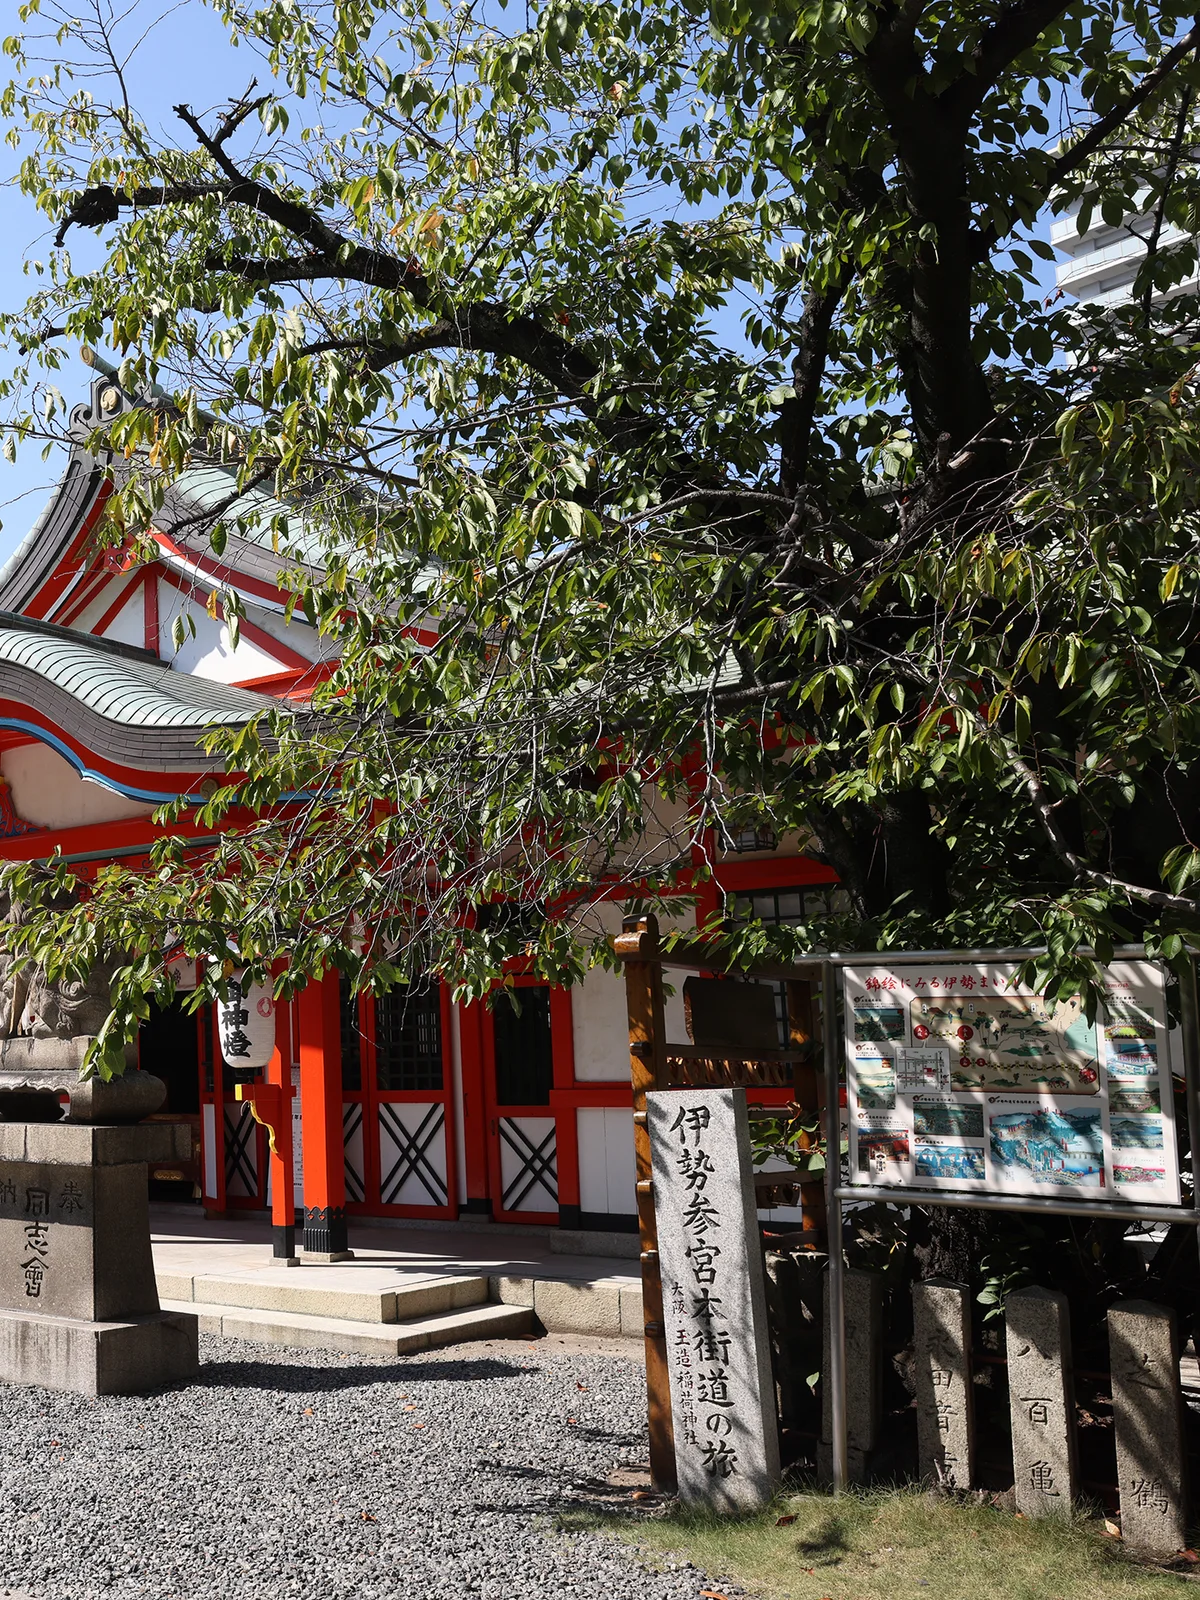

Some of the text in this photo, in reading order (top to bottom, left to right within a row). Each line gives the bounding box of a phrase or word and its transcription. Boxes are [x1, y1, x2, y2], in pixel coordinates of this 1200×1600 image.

[865, 974, 1018, 993] 錦絵にみる伊勢まい
[669, 1105, 738, 1479] 伊勢参宮本街道の旅
[671, 1281, 699, 1446] 大阪・玉造稲荷神社
[1017, 1337, 1060, 1497] 八百亀
